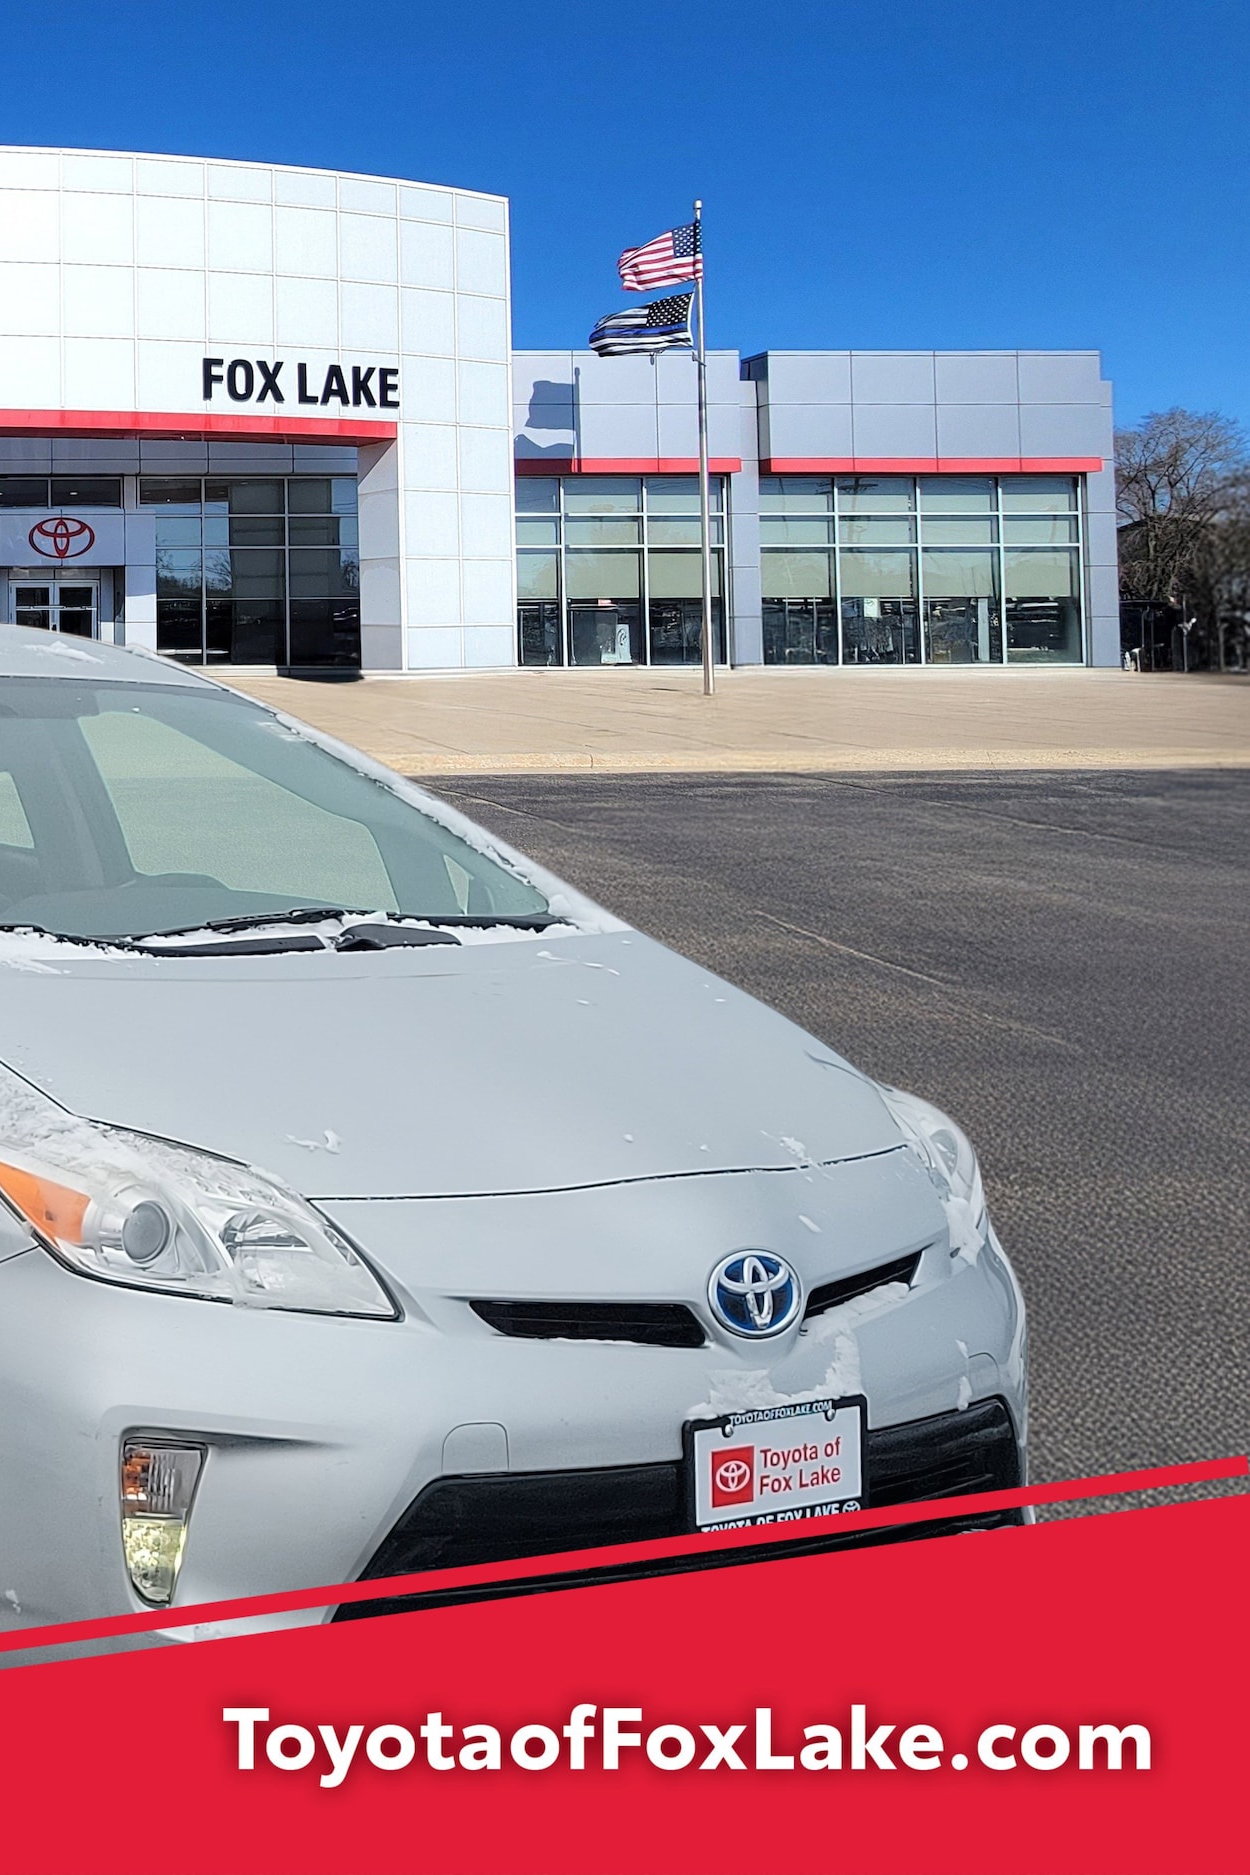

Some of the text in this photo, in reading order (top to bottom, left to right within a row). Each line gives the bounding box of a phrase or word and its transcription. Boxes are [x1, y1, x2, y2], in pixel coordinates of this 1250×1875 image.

[203, 357, 400, 408] FOX LAKE
[759, 1436, 841, 1471] Toyota of
[759, 1465, 841, 1496] Fox Lake
